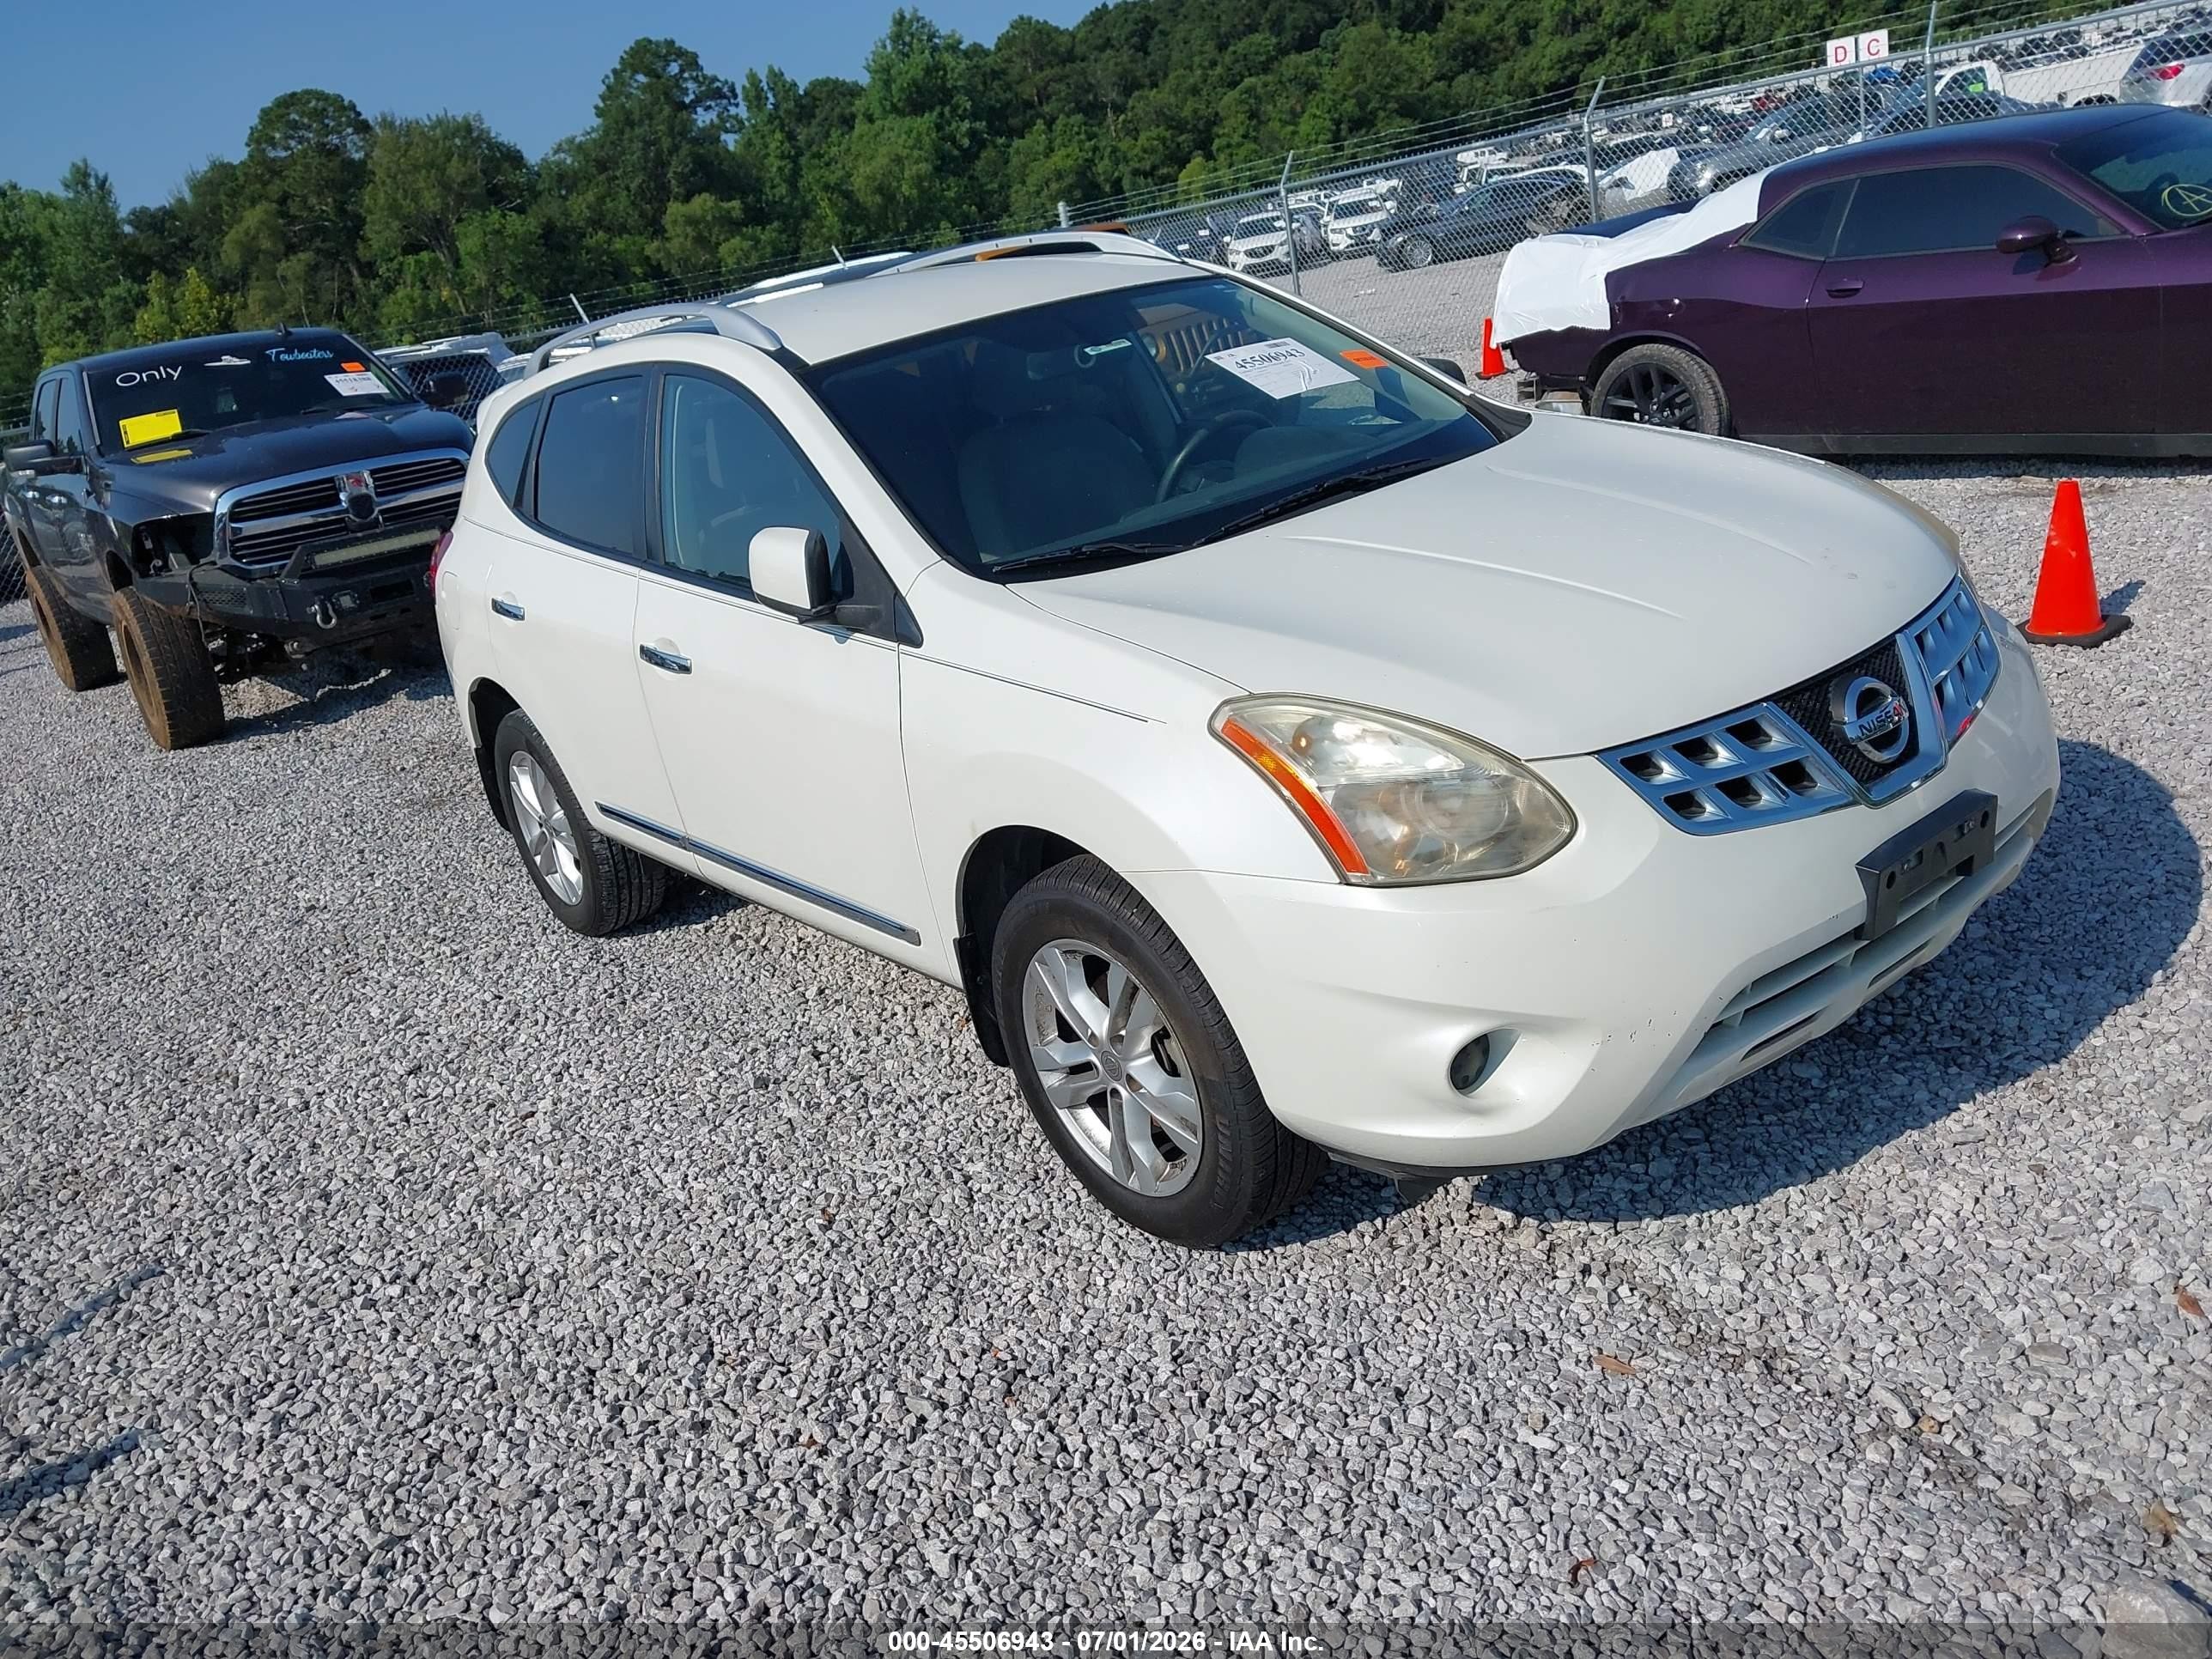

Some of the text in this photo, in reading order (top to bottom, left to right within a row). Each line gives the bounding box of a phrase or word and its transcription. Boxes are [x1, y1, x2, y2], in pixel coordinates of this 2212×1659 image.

[1834, 46, 1847, 63] D
[1867, 38, 1880, 56] C
[1235, 348, 1305, 369] 45506943
[116, 366, 182, 386] Only
